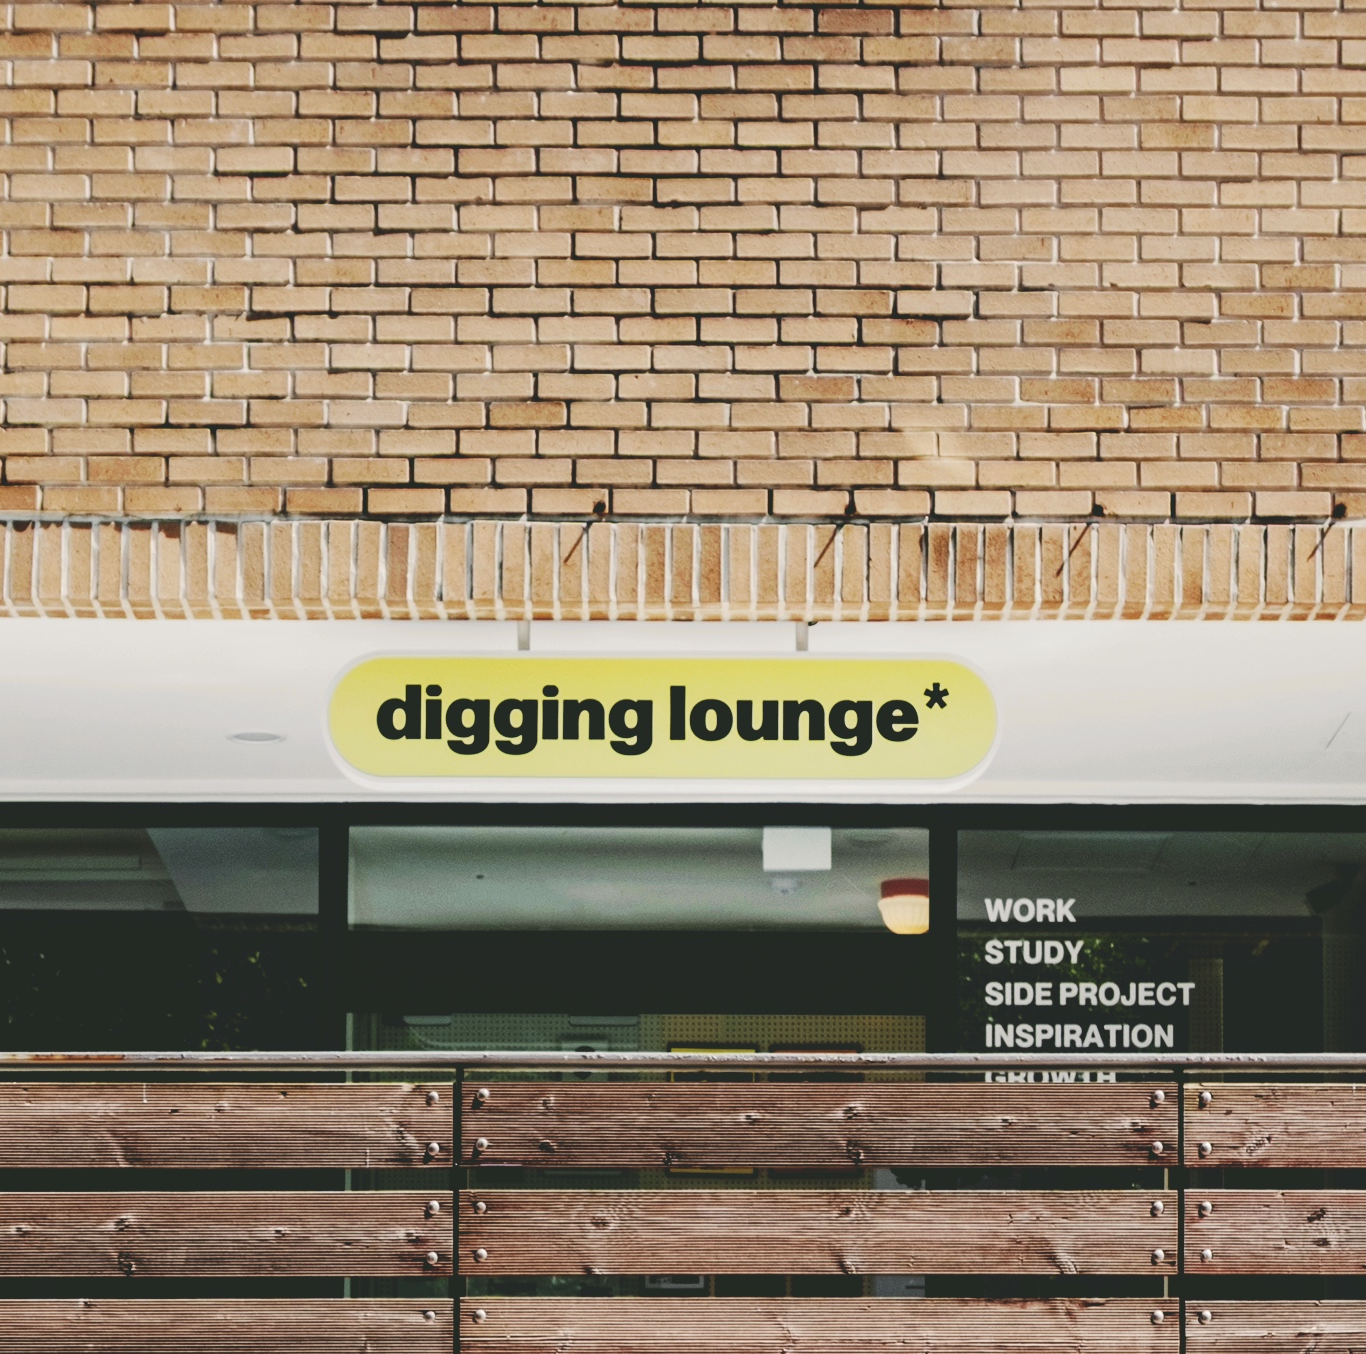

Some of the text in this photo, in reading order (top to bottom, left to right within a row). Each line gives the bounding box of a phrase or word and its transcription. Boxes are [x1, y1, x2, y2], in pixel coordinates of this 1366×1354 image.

[377, 684, 654, 756] digging
[985, 898, 1076, 923] WORK
[985, 940, 1084, 965] STUDY
[985, 982, 1195, 1006] SIDE PROJECT
[985, 1024, 1174, 1048] INSPIRATION
